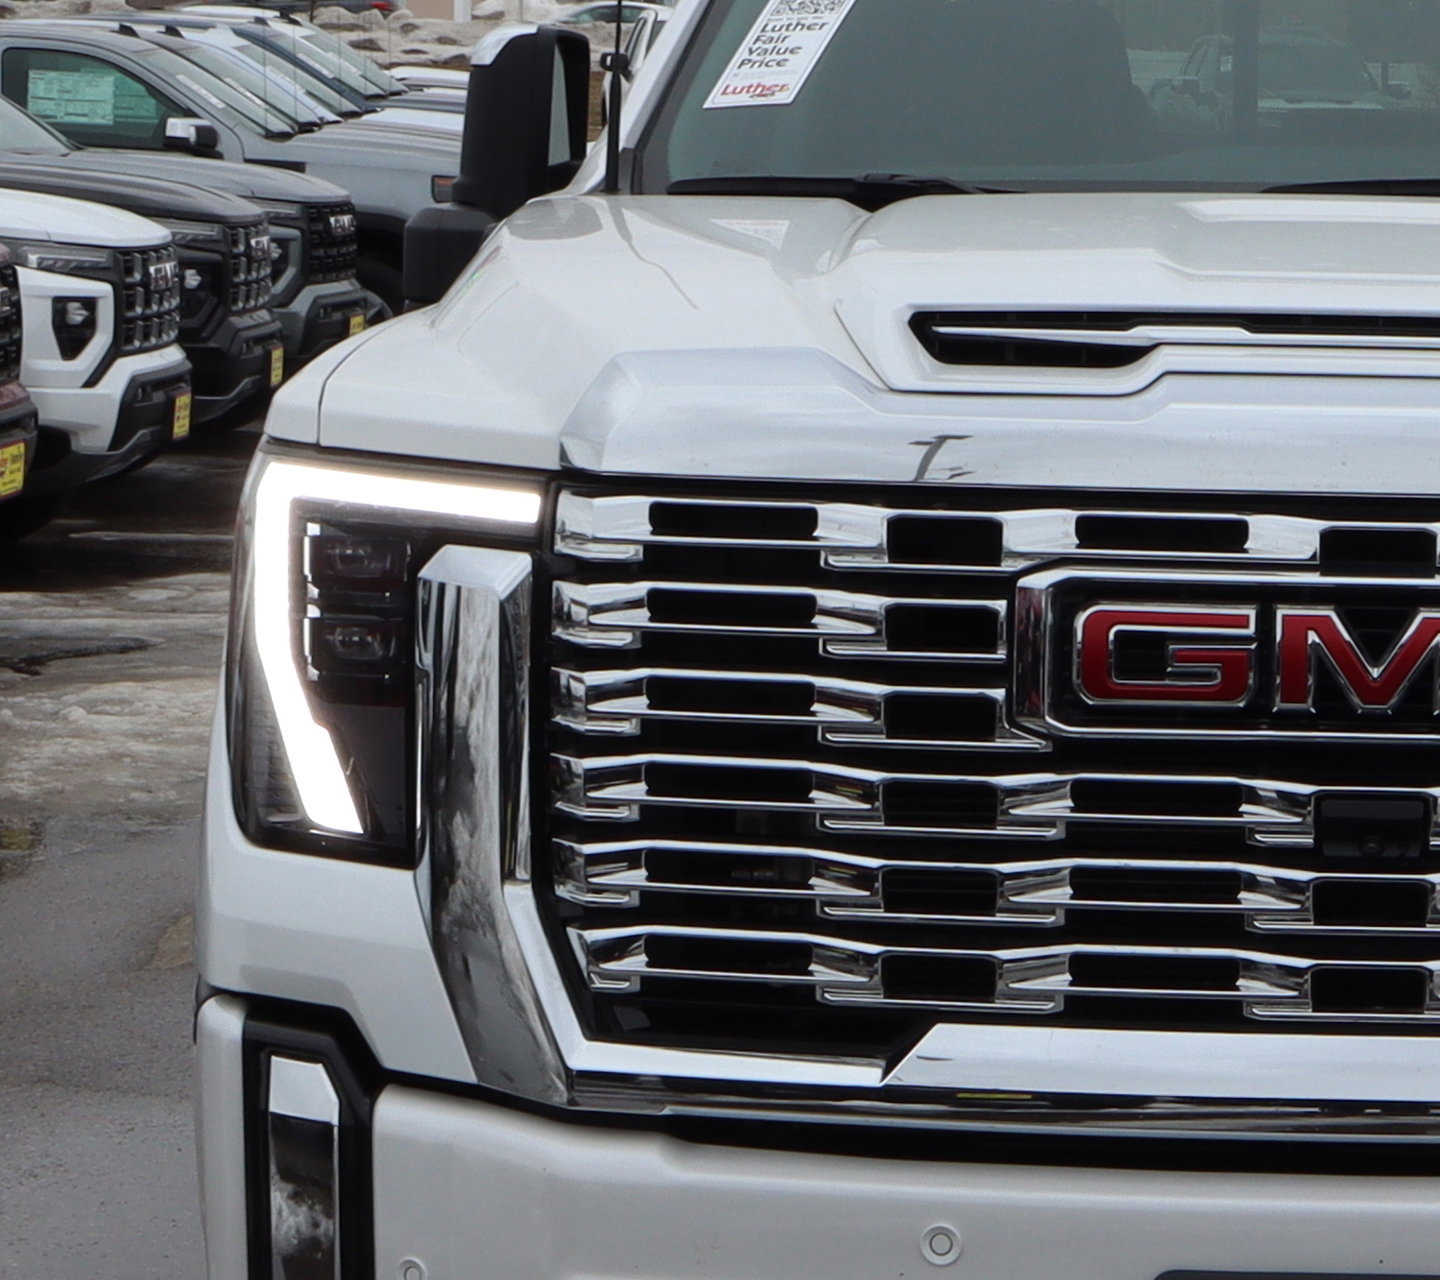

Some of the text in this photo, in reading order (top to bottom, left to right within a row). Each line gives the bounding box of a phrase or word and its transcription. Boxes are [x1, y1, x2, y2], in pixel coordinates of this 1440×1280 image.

[761, 21, 829, 33] Luther
[752, 33, 791, 46] Fair
[748, 45, 803, 57] Value
[737, 58, 790, 70] Price
[720, 82, 790, 96] Luther
